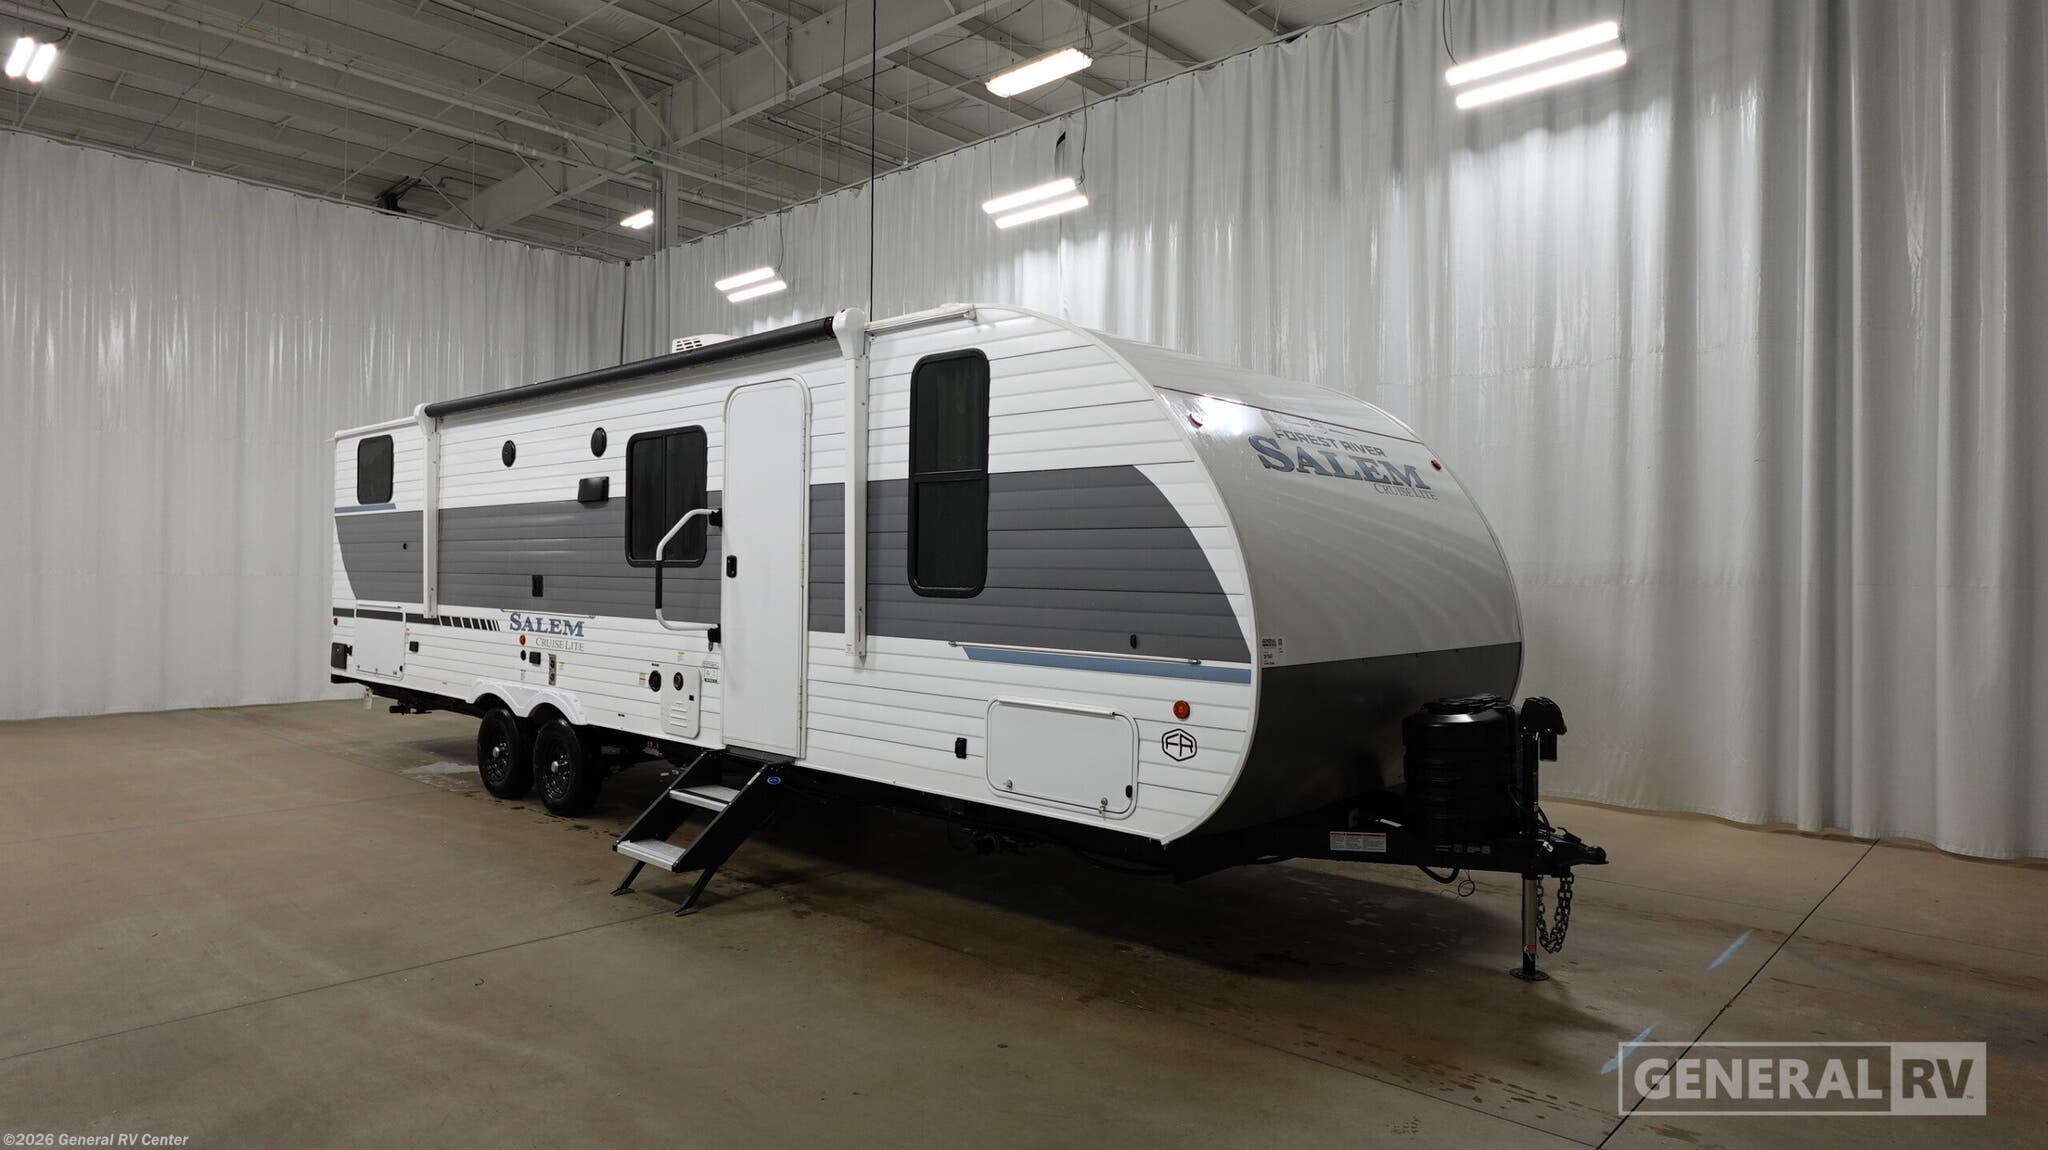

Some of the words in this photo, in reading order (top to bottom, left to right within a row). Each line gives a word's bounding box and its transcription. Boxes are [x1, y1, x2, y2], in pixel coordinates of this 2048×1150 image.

[1275, 430, 1339, 448] FOREST
[1341, 441, 1387, 457] RIVER
[1248, 435, 1431, 489] SALEM
[510, 612, 584, 637] SALEM
